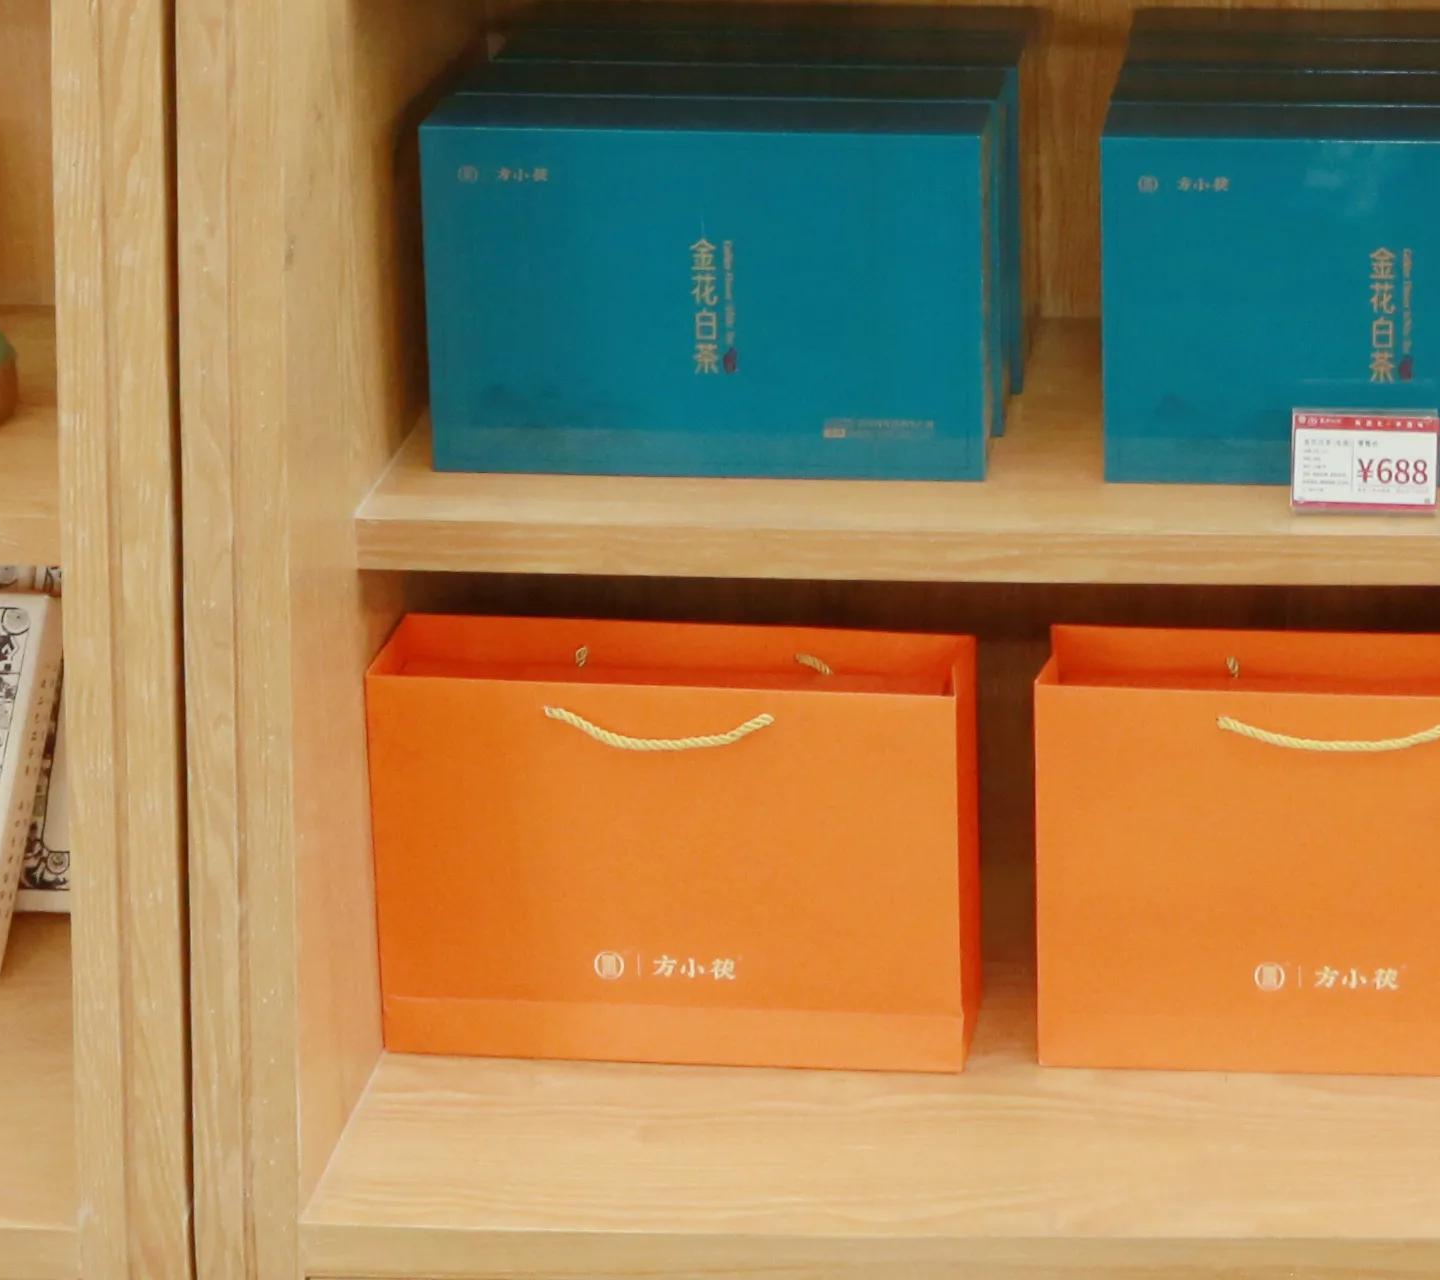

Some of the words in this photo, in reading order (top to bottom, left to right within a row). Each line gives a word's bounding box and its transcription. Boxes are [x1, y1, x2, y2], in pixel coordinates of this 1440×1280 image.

[689, 238, 719, 374] 金花白茶
[1370, 247, 1396, 383] 金花白茶
[1357, 458, 1427, 484] ¥688
